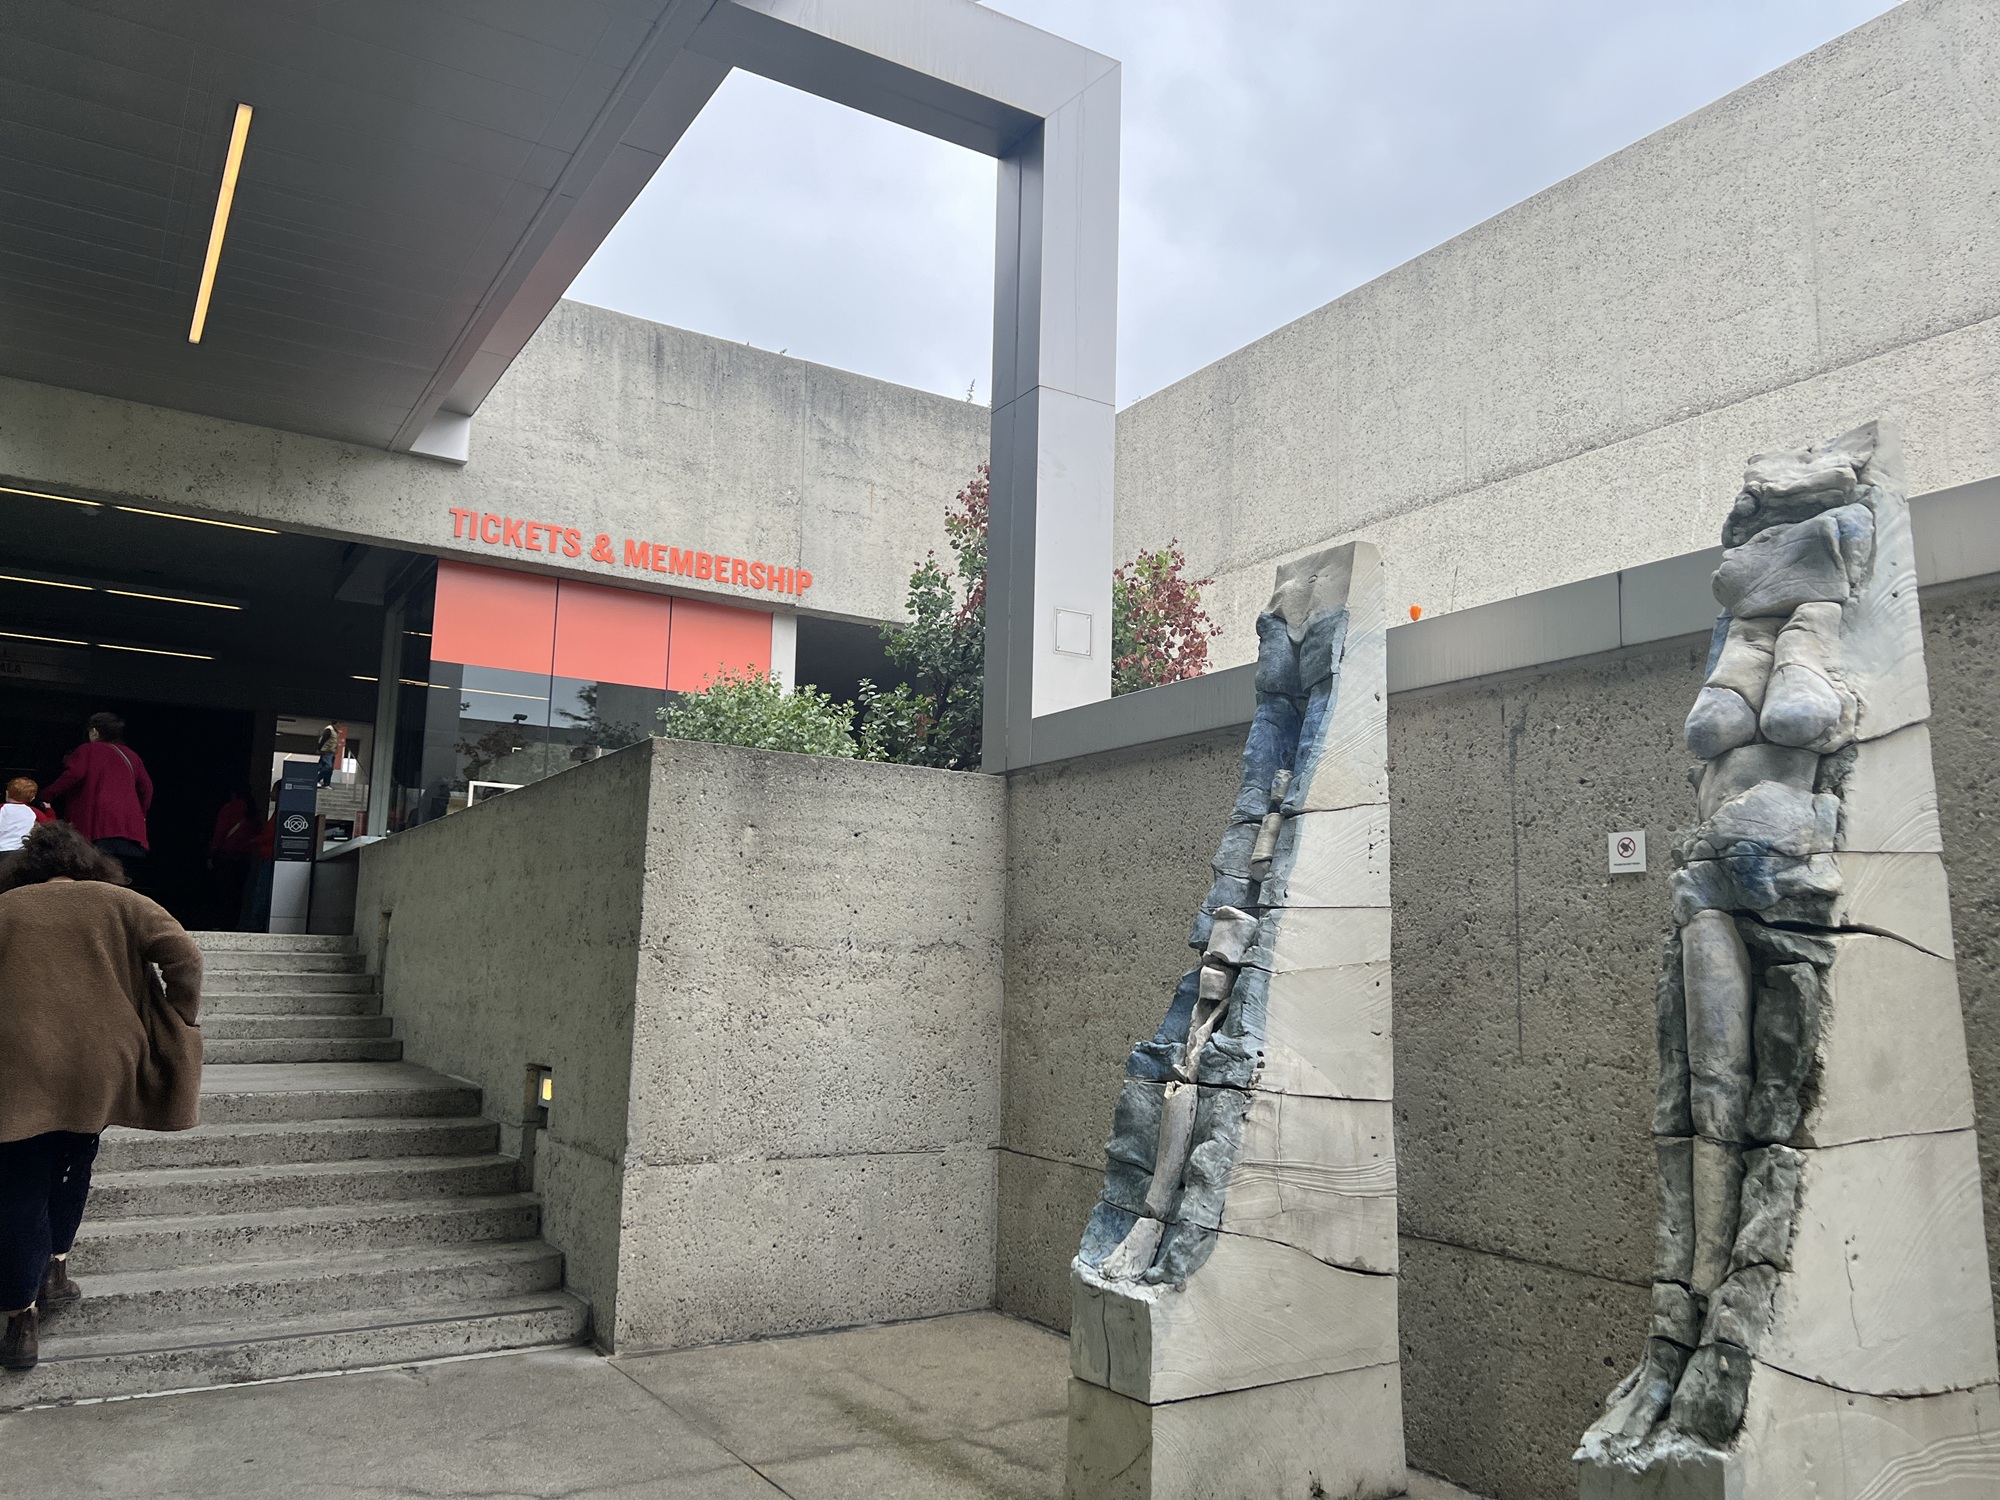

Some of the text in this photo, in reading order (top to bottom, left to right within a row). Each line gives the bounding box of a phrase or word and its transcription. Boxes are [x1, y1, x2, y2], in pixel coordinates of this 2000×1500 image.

[449, 507, 812, 596] TICKETS & MEMBERSHIP
